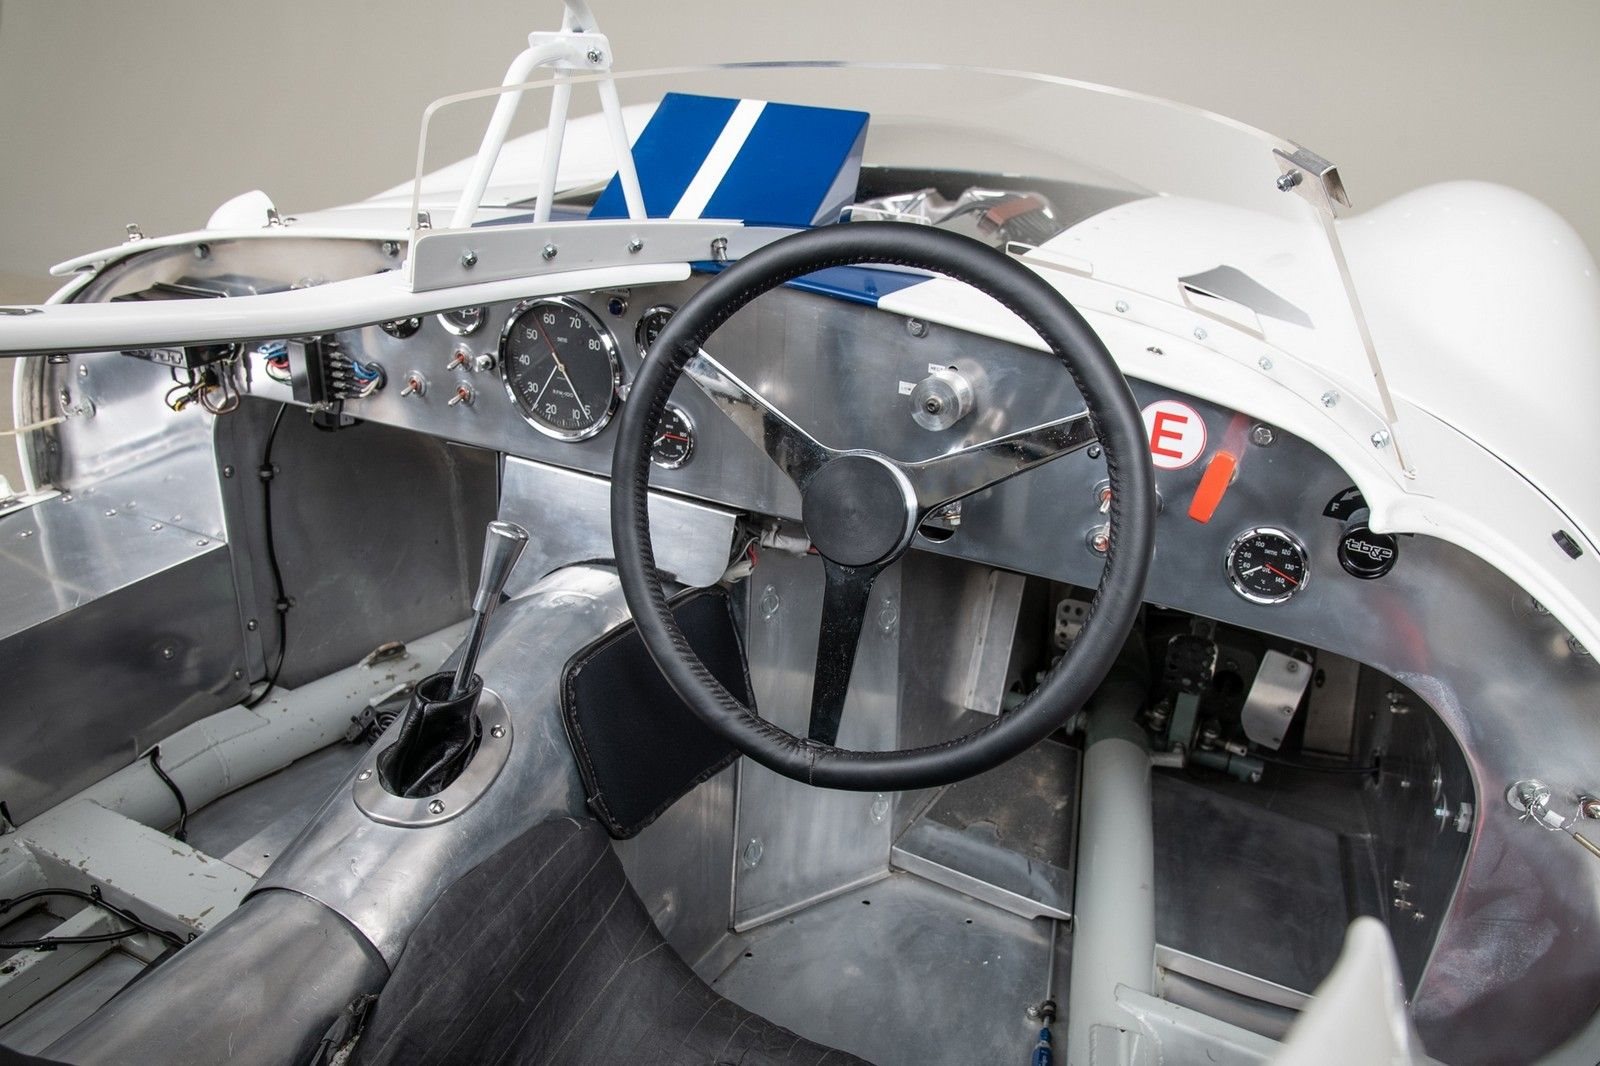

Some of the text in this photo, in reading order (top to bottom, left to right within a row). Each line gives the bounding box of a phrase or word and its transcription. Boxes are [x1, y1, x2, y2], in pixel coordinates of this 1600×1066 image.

[543, 313, 555, 324] 60
[569, 317, 581, 329] 70
[526, 329, 538, 340] 50
[588, 339, 600, 350] 80
[519, 354, 530, 365] 40
[527, 382, 538, 393] 30
[545, 403, 557, 415] 20
[572, 409, 581, 420] 10
[1150, 411, 1188, 459] E
[1331, 502, 1340, 512] F
[1255, 540, 1265, 548] 100
[1275, 576, 1285, 584] 140
